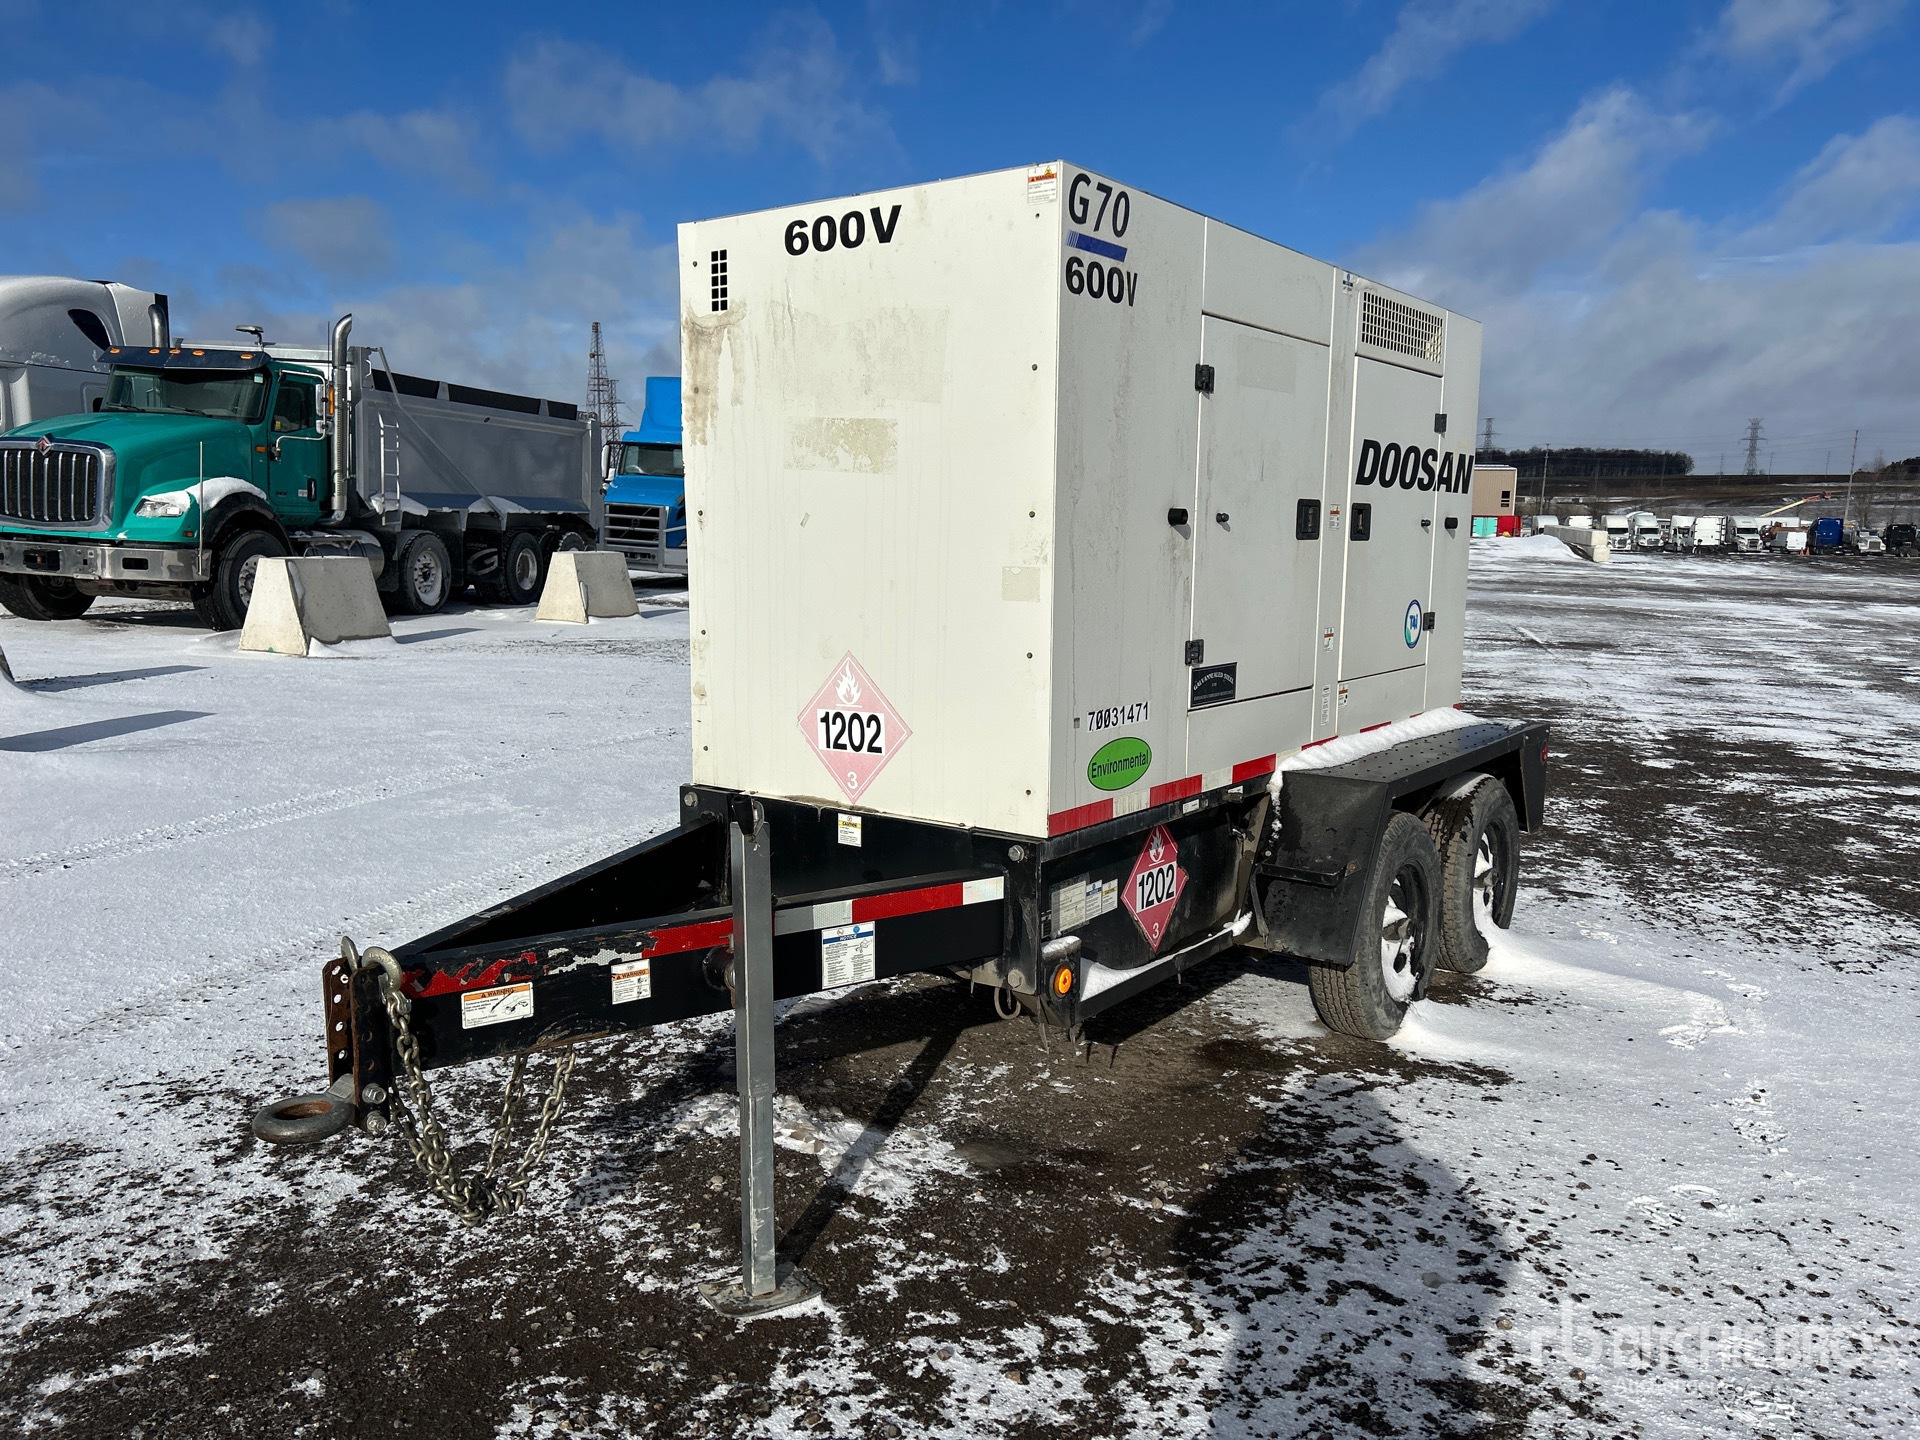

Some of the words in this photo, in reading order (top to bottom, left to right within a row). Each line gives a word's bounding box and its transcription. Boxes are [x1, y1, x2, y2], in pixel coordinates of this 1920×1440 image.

[1068, 173, 1130, 238] G70
[784, 204, 902, 256] 600V
[1065, 256, 1138, 307] 600V
[1355, 439, 1474, 494] DOOSAN
[820, 711, 882, 754] 1202
[1088, 701, 1148, 731] 70031471
[847, 771, 858, 789] 3
[1091, 749, 1149, 779] Environmental
[1138, 863, 1175, 909] 1202
[1152, 922, 1159, 939] 3
